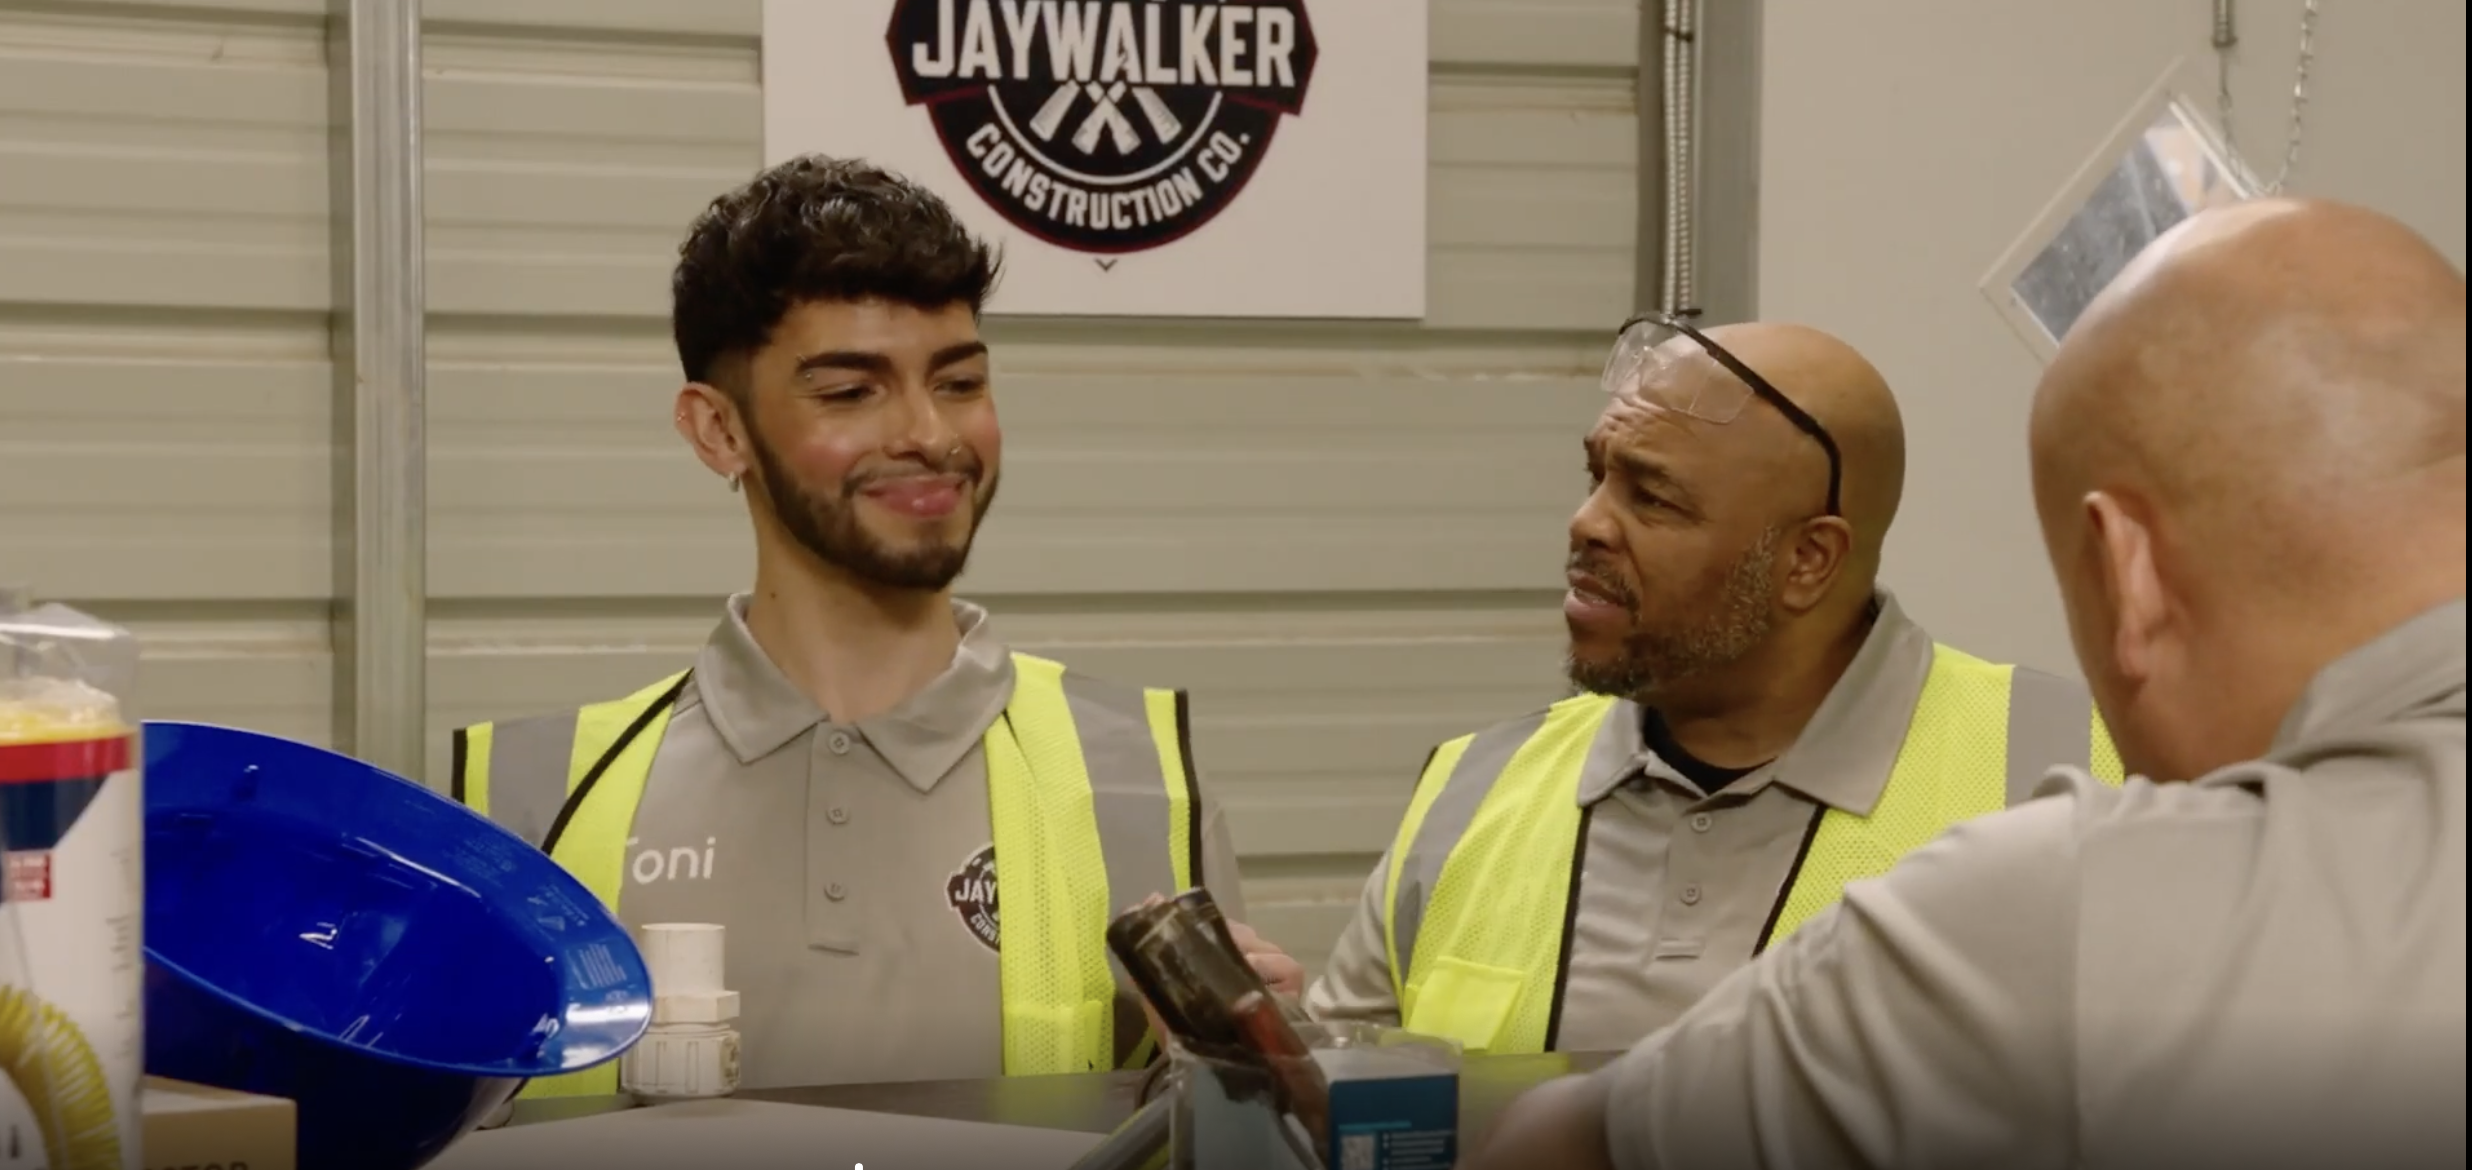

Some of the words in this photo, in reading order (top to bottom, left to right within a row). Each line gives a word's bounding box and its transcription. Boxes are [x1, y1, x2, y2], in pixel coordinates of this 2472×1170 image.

[912, 0, 1296, 87] JAYWALKER
[966, 122, 1203, 230] CONSTRUCTION
[1198, 130, 1251, 183] CO.
[626, 836, 717, 885] oni
